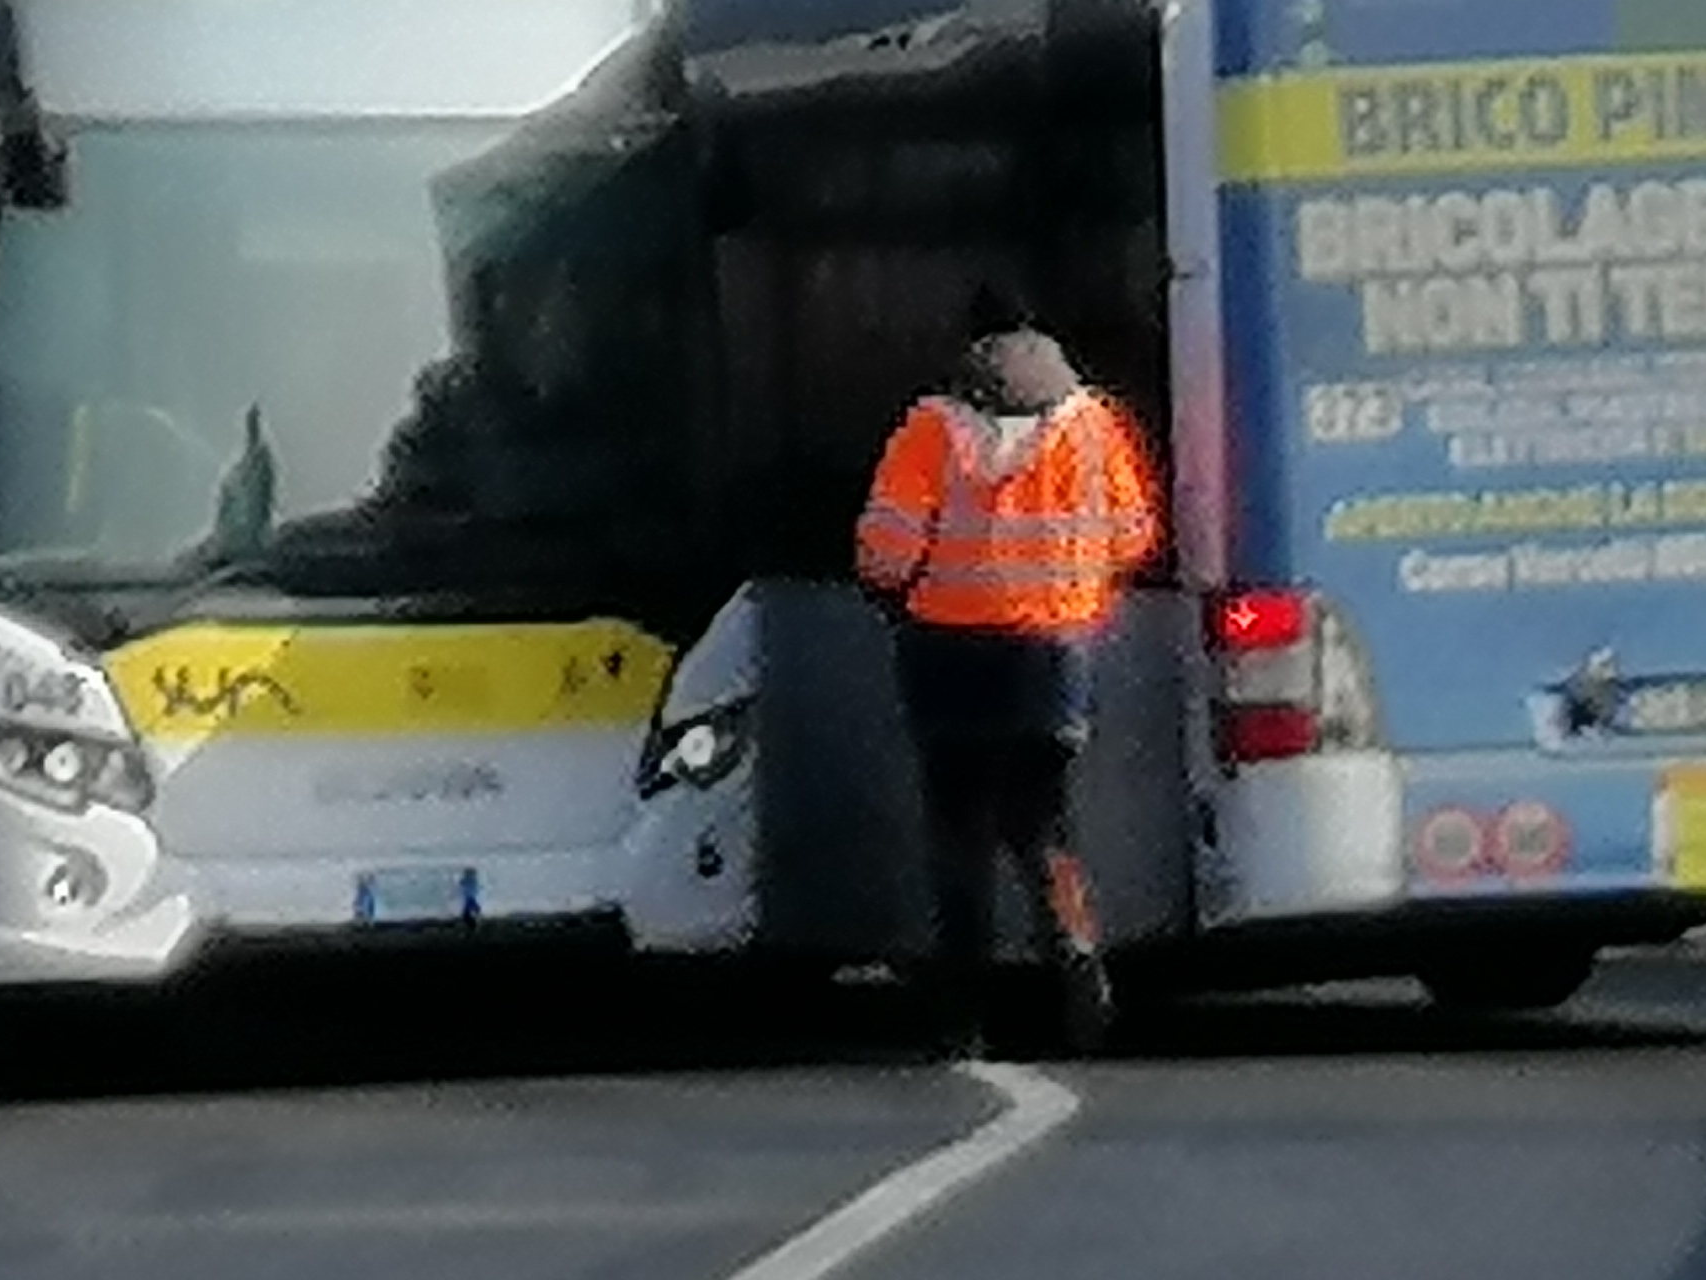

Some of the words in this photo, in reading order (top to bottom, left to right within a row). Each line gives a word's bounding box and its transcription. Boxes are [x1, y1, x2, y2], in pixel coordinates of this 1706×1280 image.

[1339, 70, 1571, 156] BRICO
[1362, 270, 1521, 356] NON
[1529, 266, 1605, 344] TI
